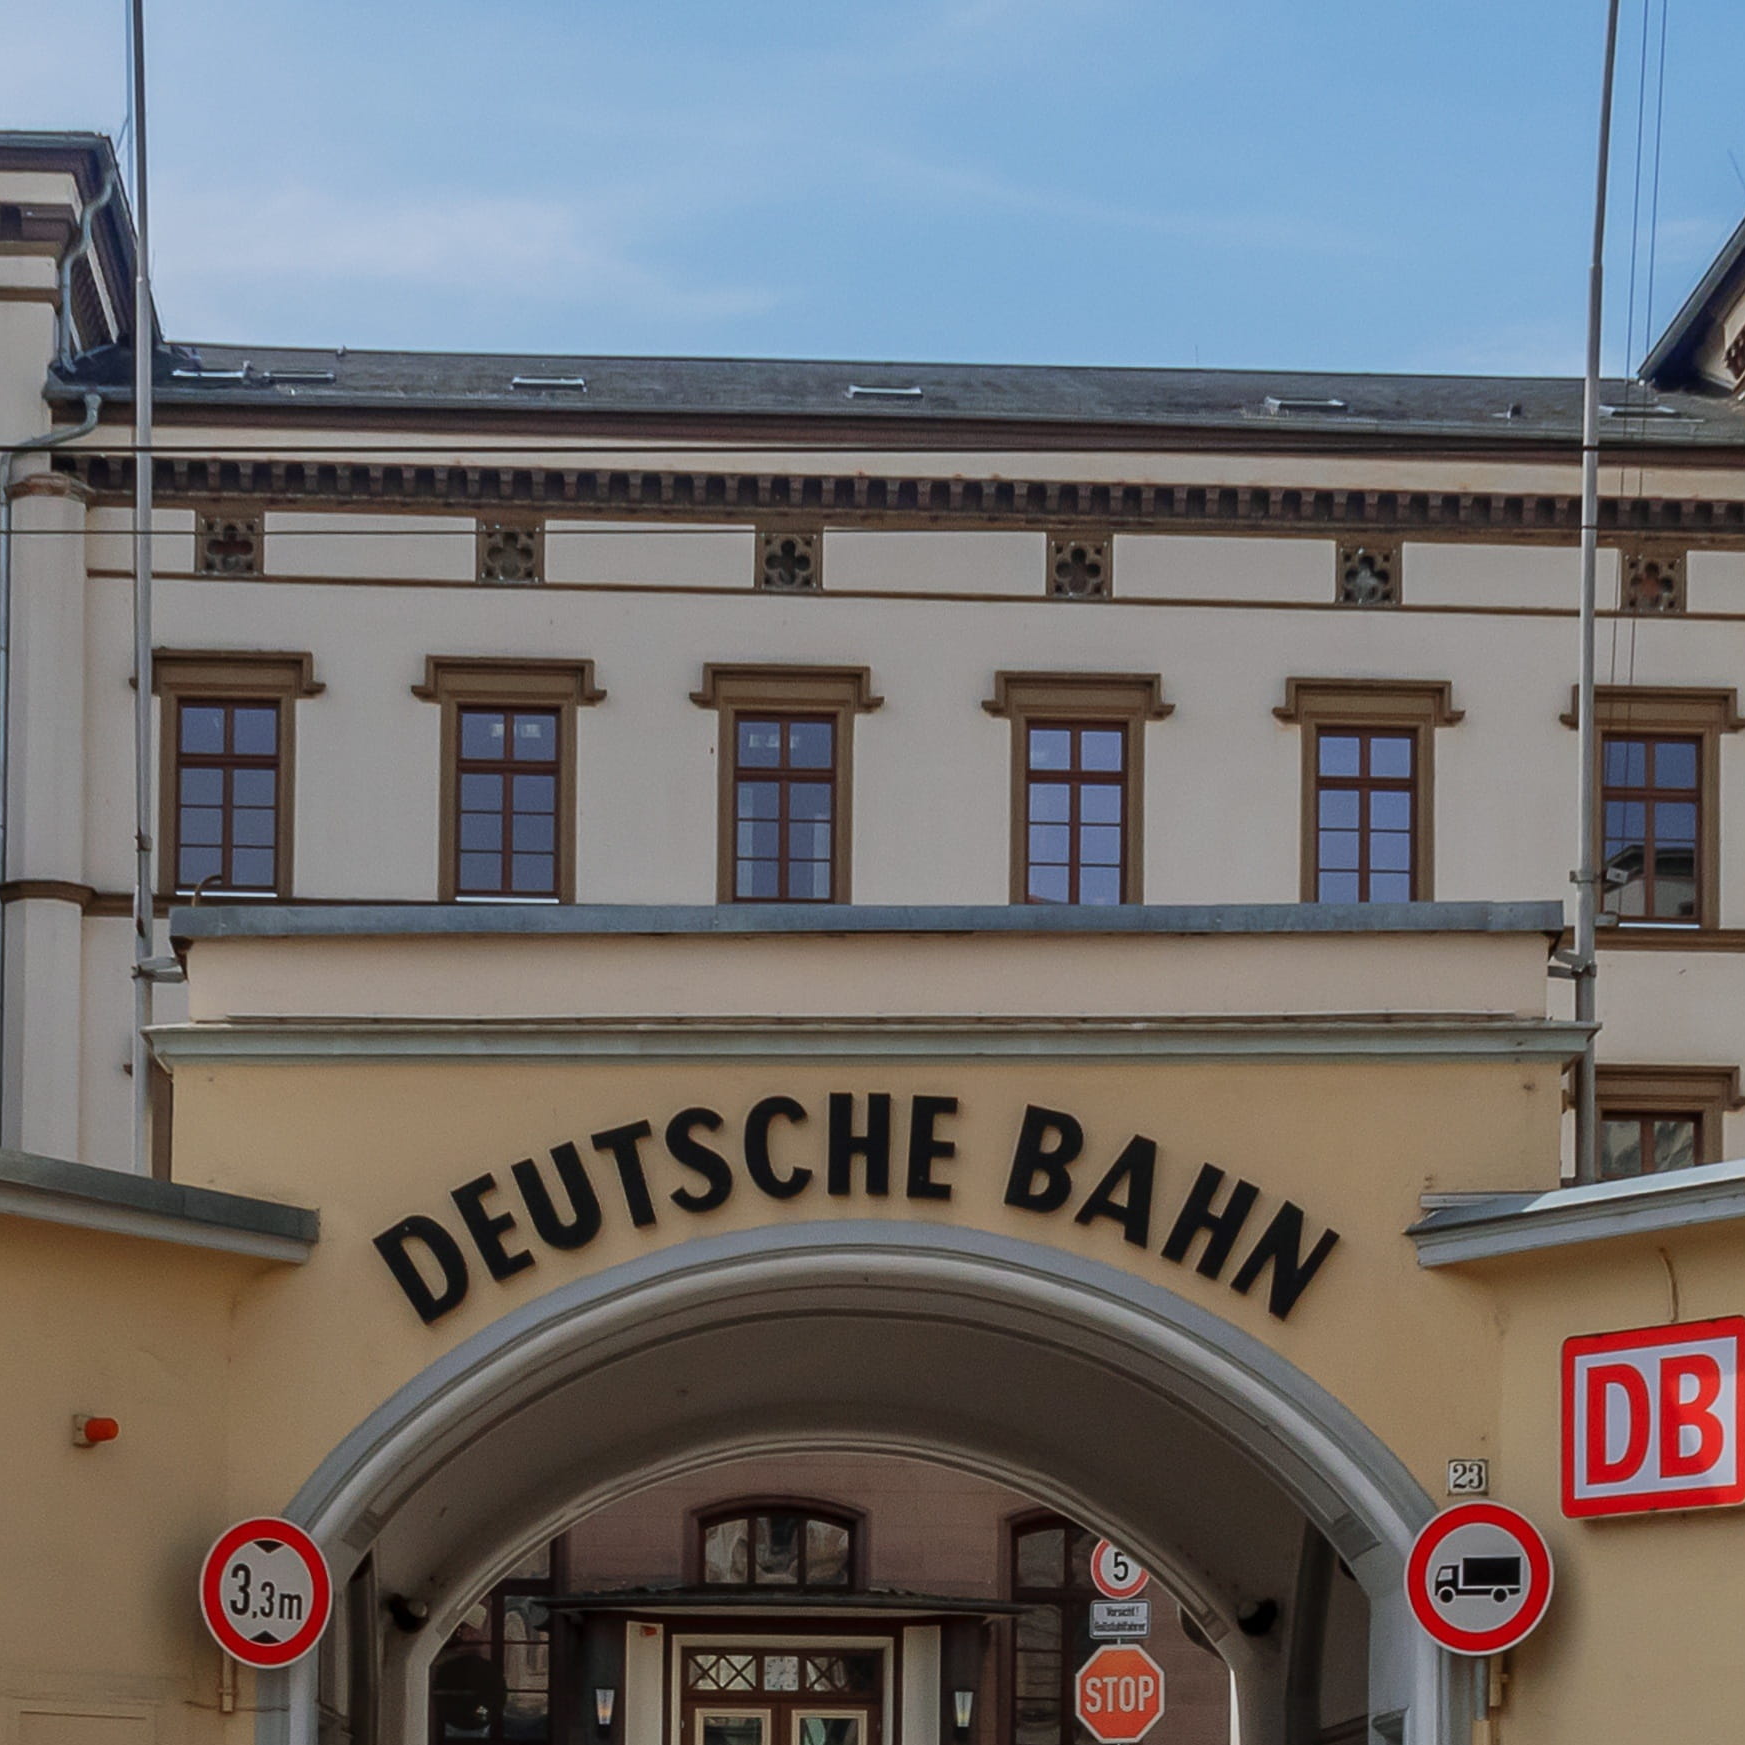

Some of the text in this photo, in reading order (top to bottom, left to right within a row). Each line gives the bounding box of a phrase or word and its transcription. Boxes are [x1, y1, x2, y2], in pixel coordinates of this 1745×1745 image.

[372, 1091, 1341, 1325] DEUTSCHE BAHN
[1586, 1353, 1724, 1486] DB
[1452, 1463, 1484, 1489] 23
[1113, 1551, 1129, 1582] 5
[229, 1563, 303, 1620] 3,3m
[1085, 1676, 1154, 1713] STOP
